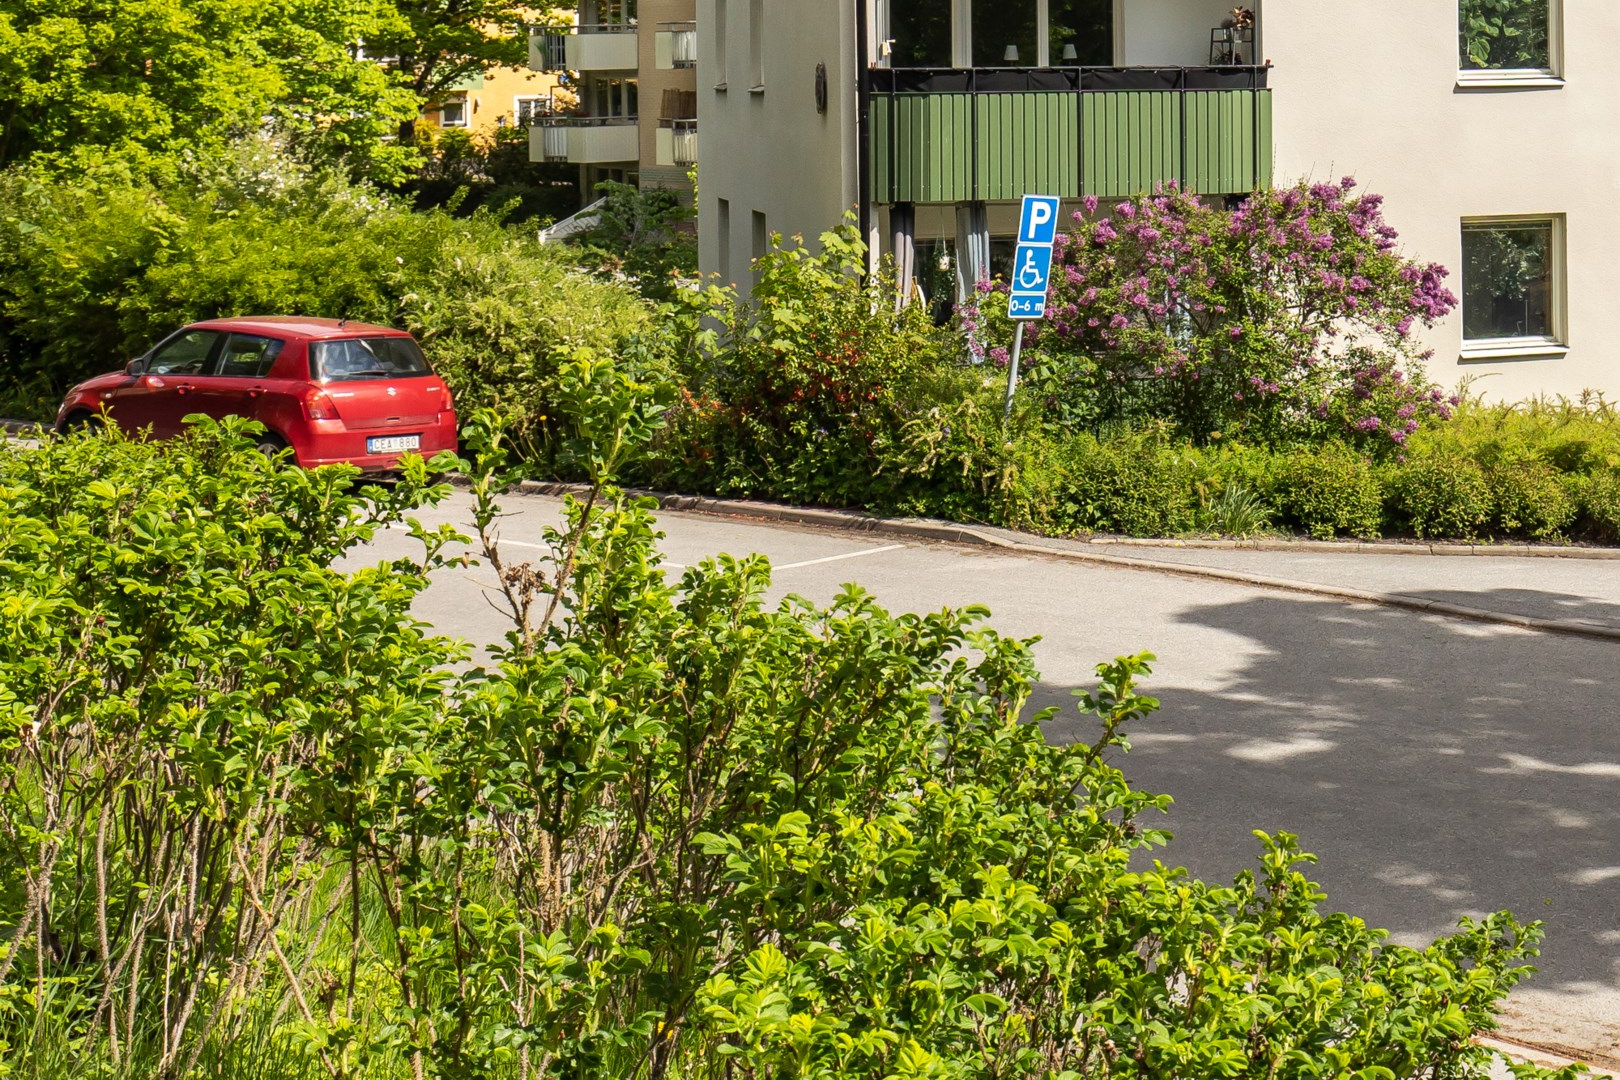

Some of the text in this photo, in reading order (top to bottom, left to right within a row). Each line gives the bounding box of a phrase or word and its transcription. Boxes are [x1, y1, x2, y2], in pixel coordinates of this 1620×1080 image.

[1028, 201, 1052, 239] P
[1011, 299, 1044, 312] 0-6 m
[374, 439, 392, 450] CEA
